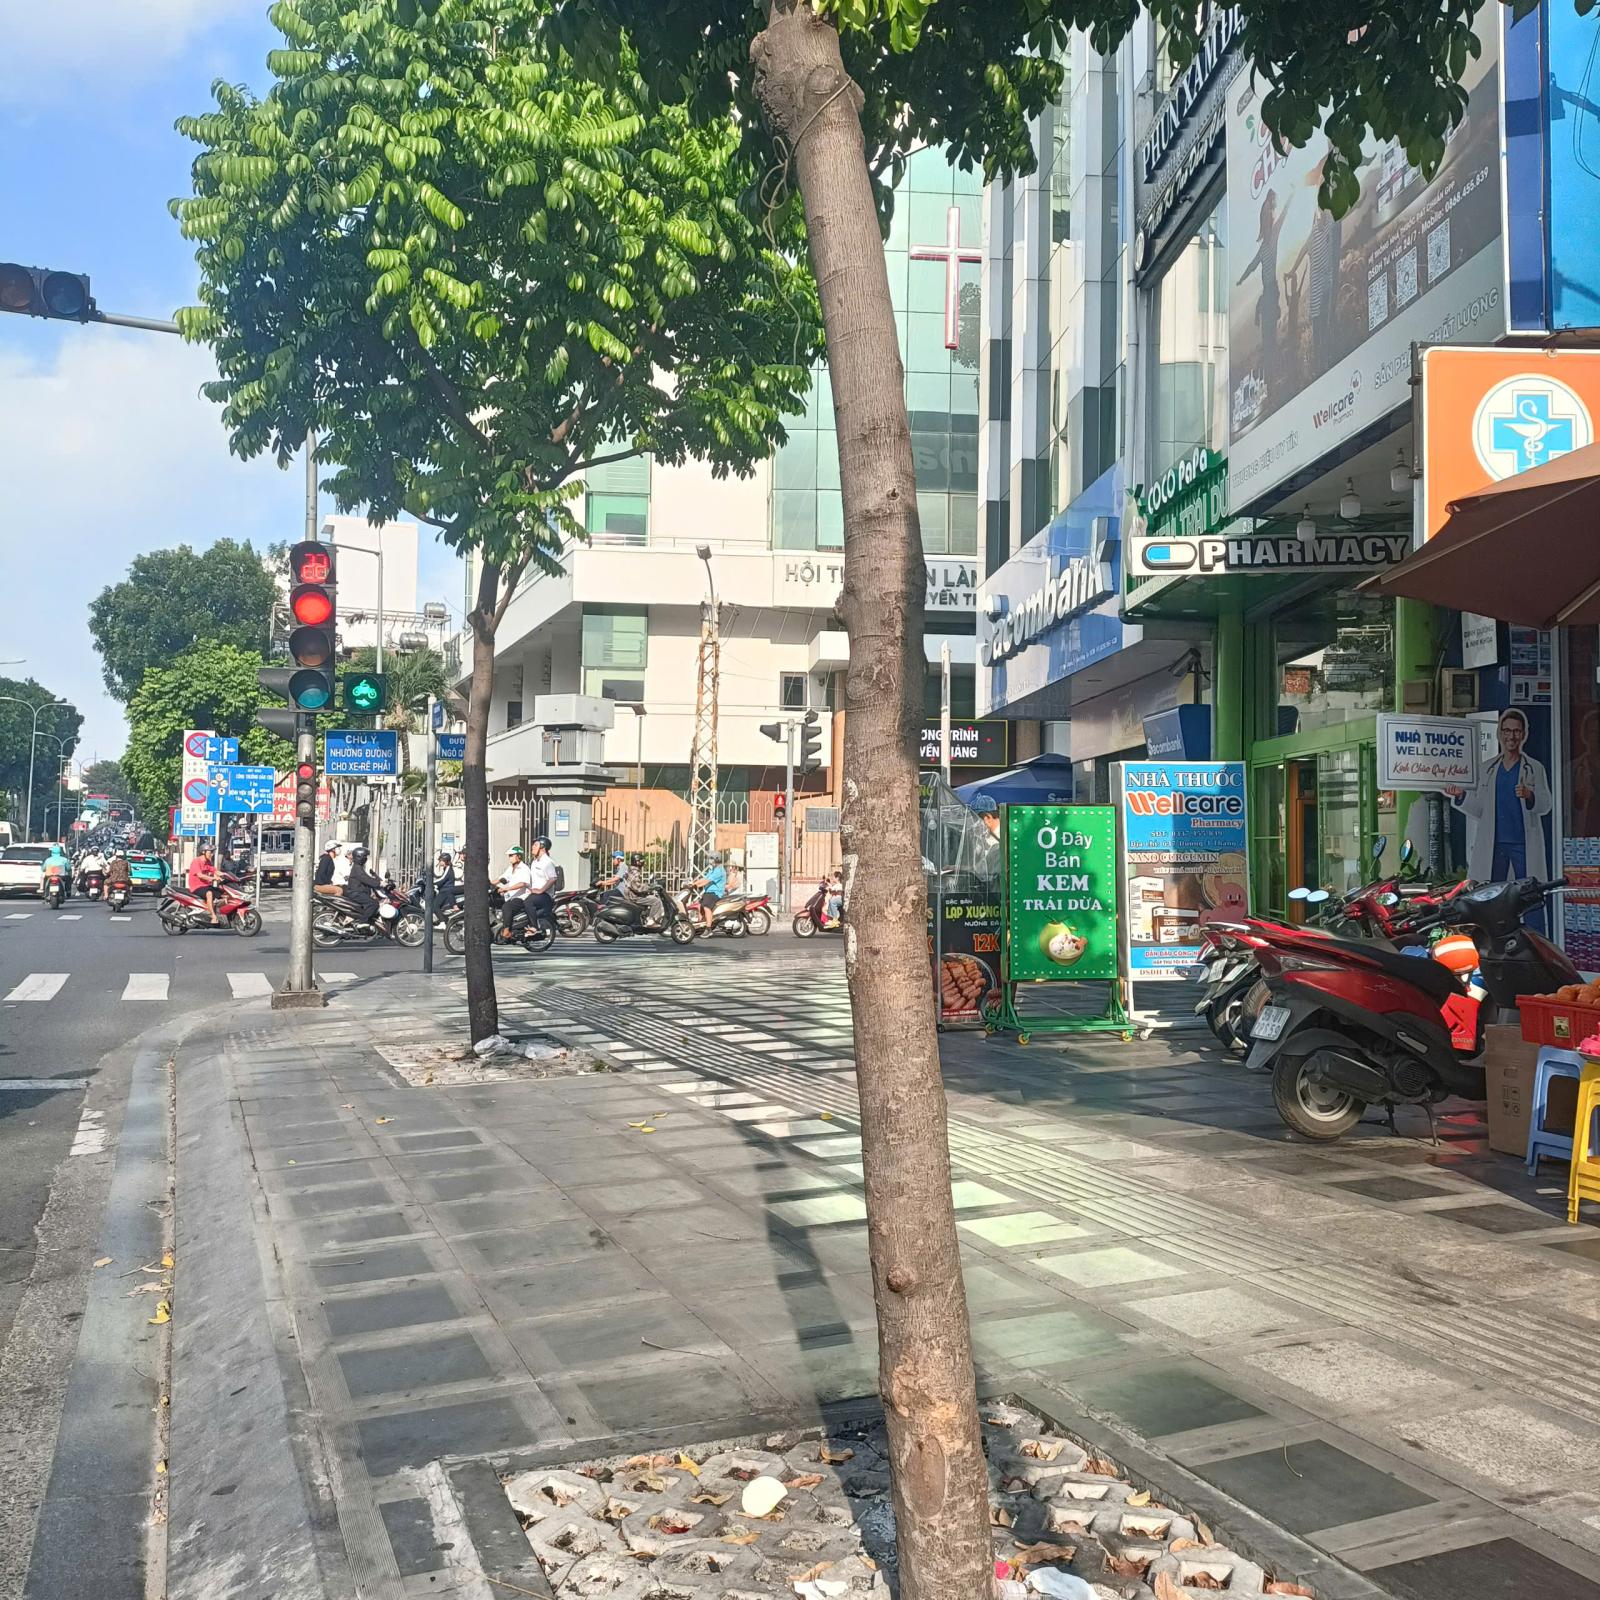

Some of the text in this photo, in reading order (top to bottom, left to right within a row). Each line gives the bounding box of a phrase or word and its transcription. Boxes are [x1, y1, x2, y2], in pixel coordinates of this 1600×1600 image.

[1142, 90, 1180, 183] PHUN
[1147, 468, 1176, 515] COCO
[1202, 537, 1409, 569] PHARMACY
[785, 560, 821, 587] HỘI
[981, 517, 1109, 667] Sacombank
[1395, 729, 1421, 743] NHÀ
[1425, 731, 1465, 746] THUỐC
[1396, 746, 1463, 758] WELLCARE
[331, 762, 348, 771] CHO
[372, 759, 391, 771] PHẢI
[1127, 767, 1242, 787] NHÀ THUỐC
[1127, 791, 1243, 815] Wellcare
[1191, 817, 1244, 829] Pharmacy
[1037, 819, 1093, 849] Ở Đây
[1045, 851, 1081, 868] Bán
[1128, 852, 1159, 863] NANO
[1037, 874, 1089, 891] KEM
[1023, 896, 1103, 911] TRÁI DỪA
[945, 906, 963, 922] LẠP
[973, 934, 1000, 952] 12K
